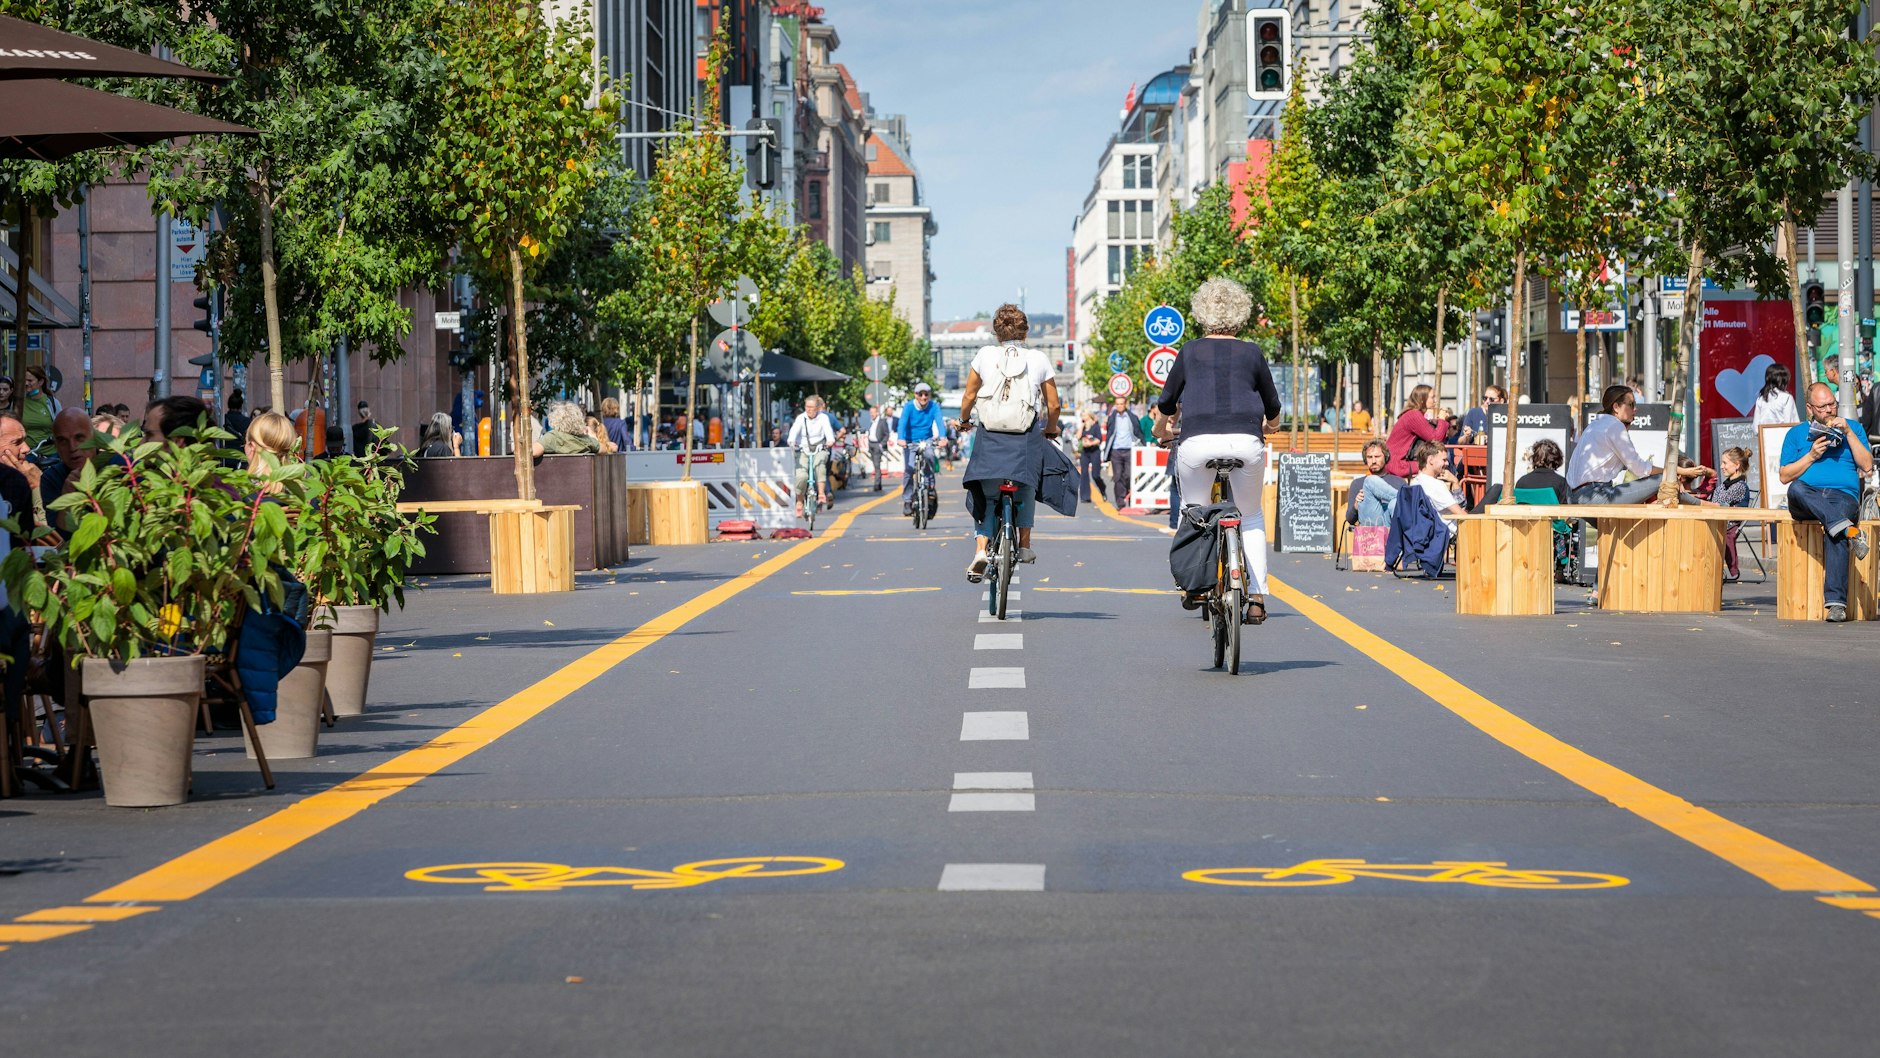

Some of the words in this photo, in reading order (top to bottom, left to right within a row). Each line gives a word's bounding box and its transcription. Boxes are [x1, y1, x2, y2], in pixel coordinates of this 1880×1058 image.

[1713, 320, 1746, 328] Minuten
[1155, 359, 1174, 374] 20
[1114, 380, 1127, 390] 20
[1492, 413, 1551, 426] Booncept
[1280, 454, 1326, 464] ChariTea
